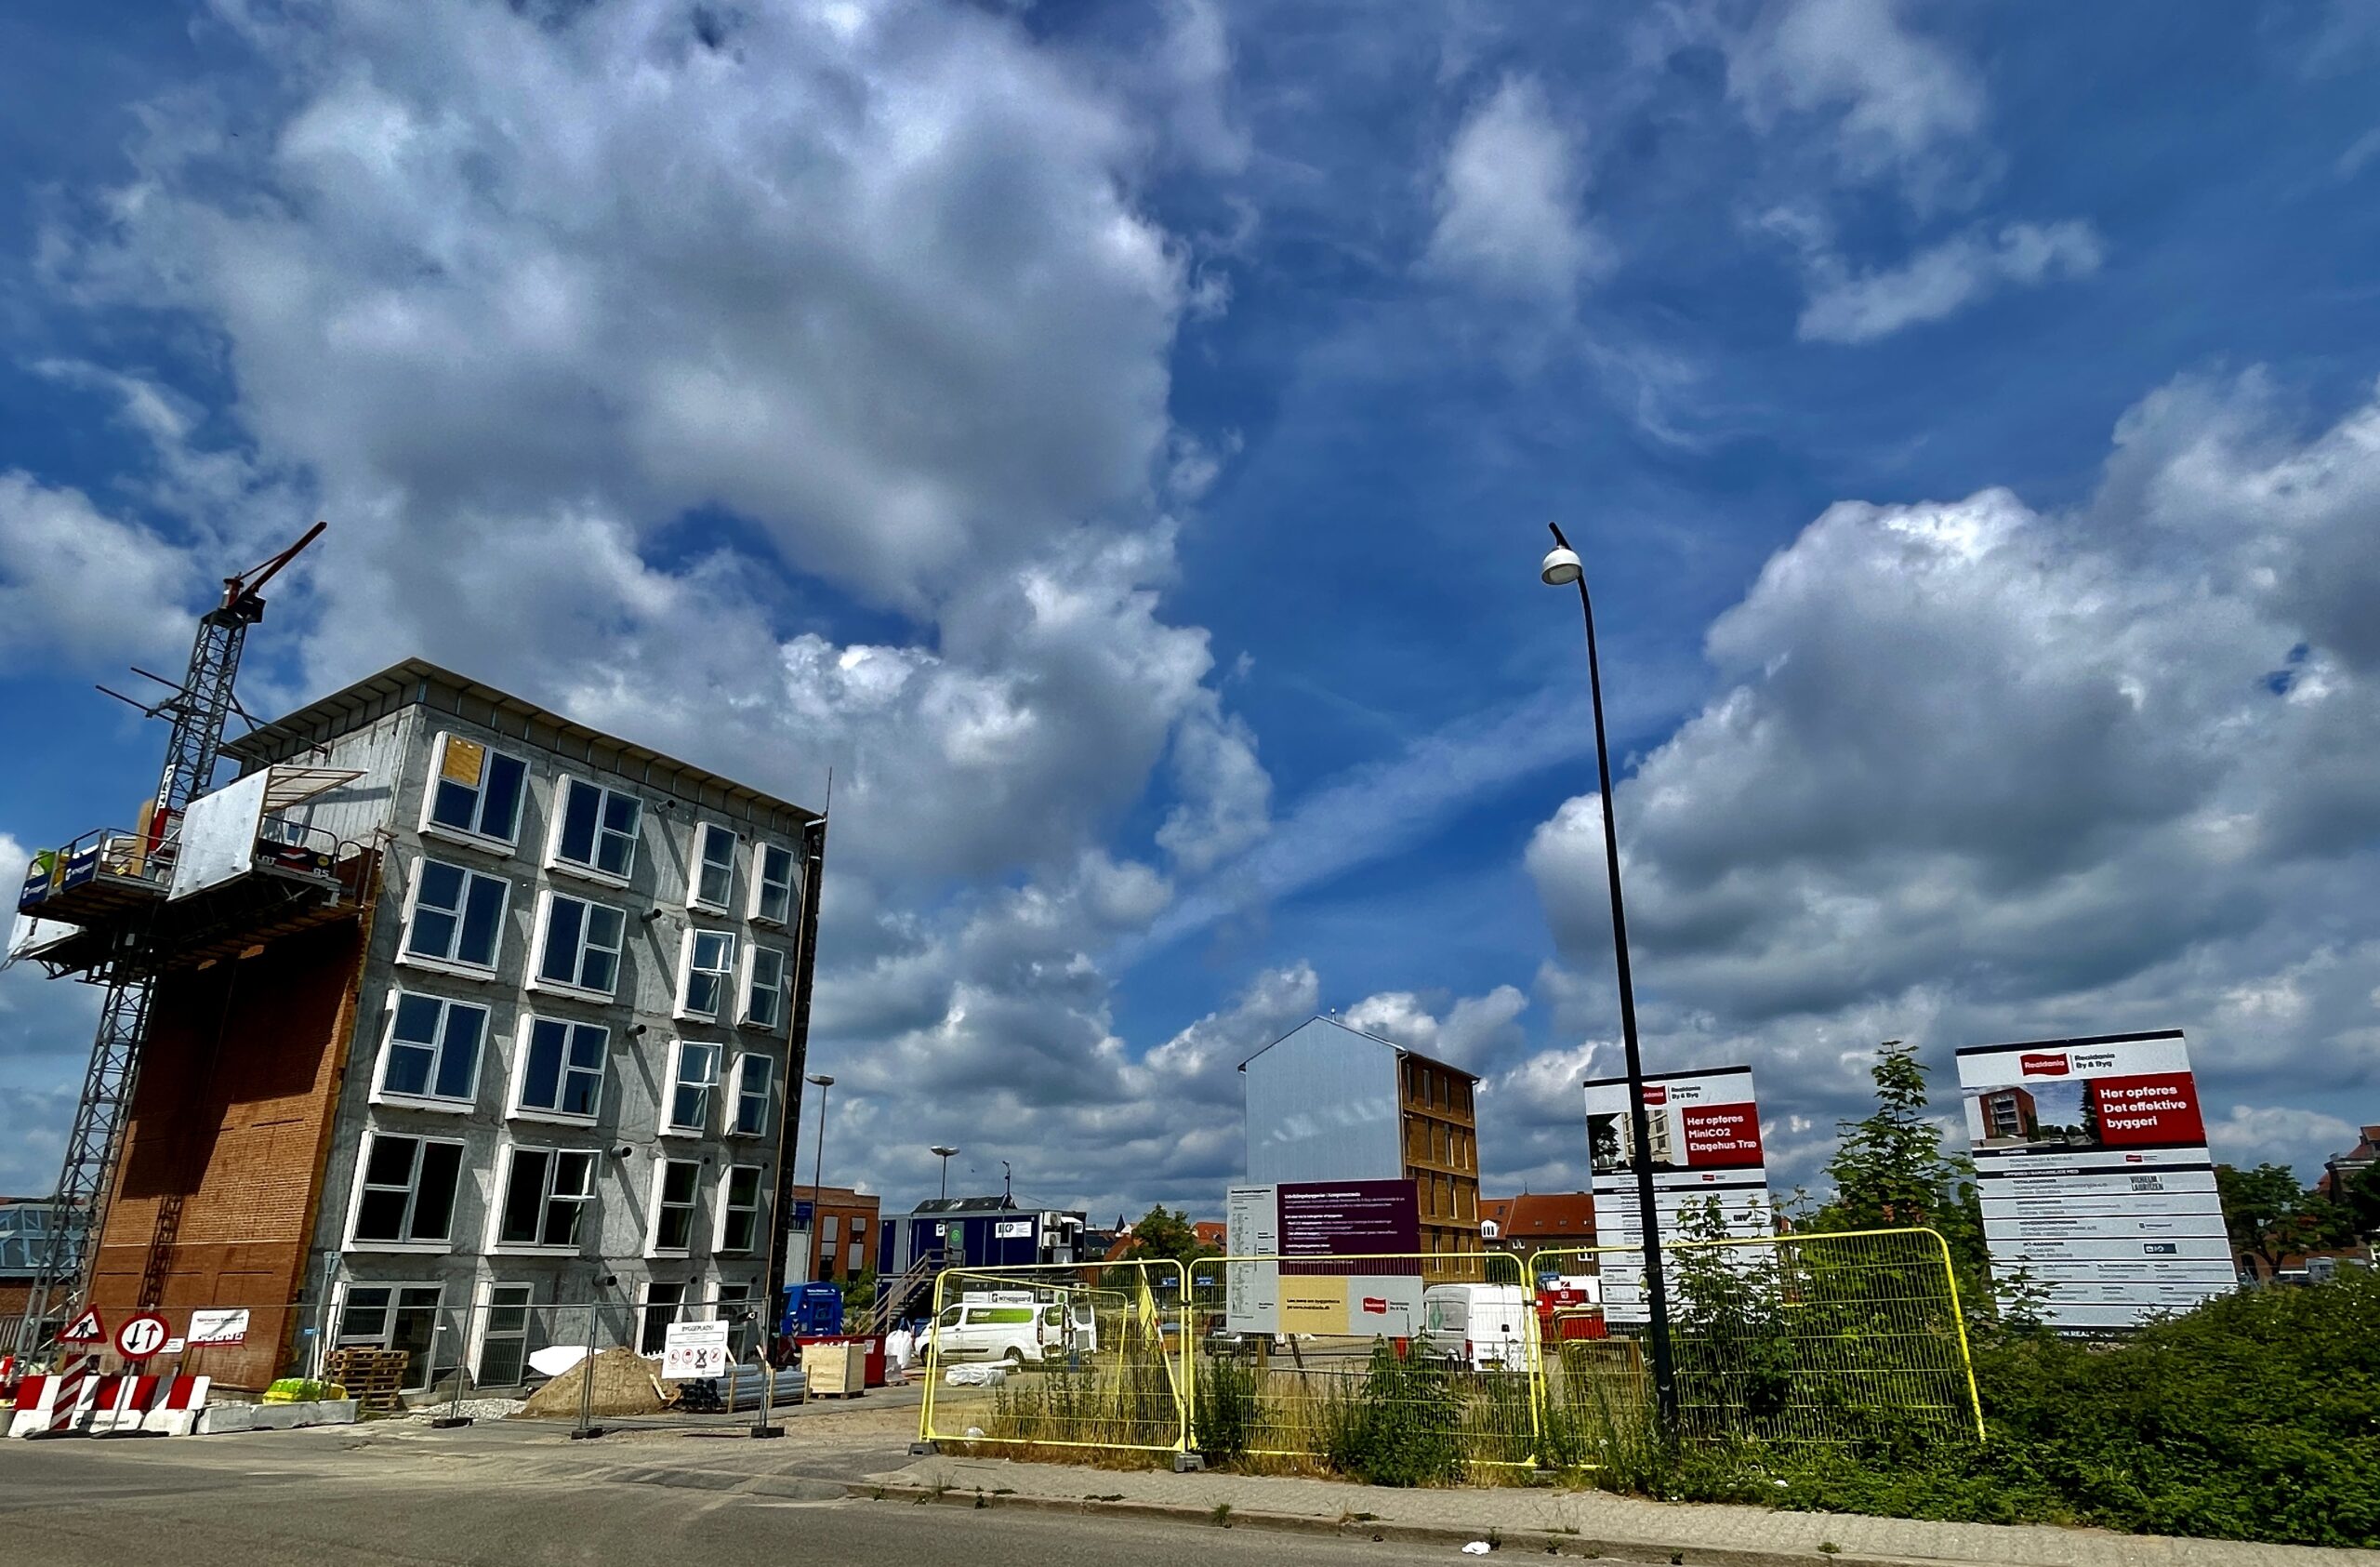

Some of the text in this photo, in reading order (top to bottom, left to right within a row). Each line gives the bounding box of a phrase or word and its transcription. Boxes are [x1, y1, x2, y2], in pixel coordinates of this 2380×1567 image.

[2074, 1053, 2115, 1061] Realdania
[2024, 1059, 2066, 1069] Realdania
[2096, 1060, 2112, 1069] Byg
[2100, 1088, 2123, 1098] Her
[2103, 1100, 2187, 1113] Det effektive
[1686, 1117, 1704, 1126] Her
[2107, 1116, 2158, 1130] byggeri
[1688, 1128, 1731, 1139] MiniCO2
[1690, 1139, 1757, 1152] Etagehus Træ
